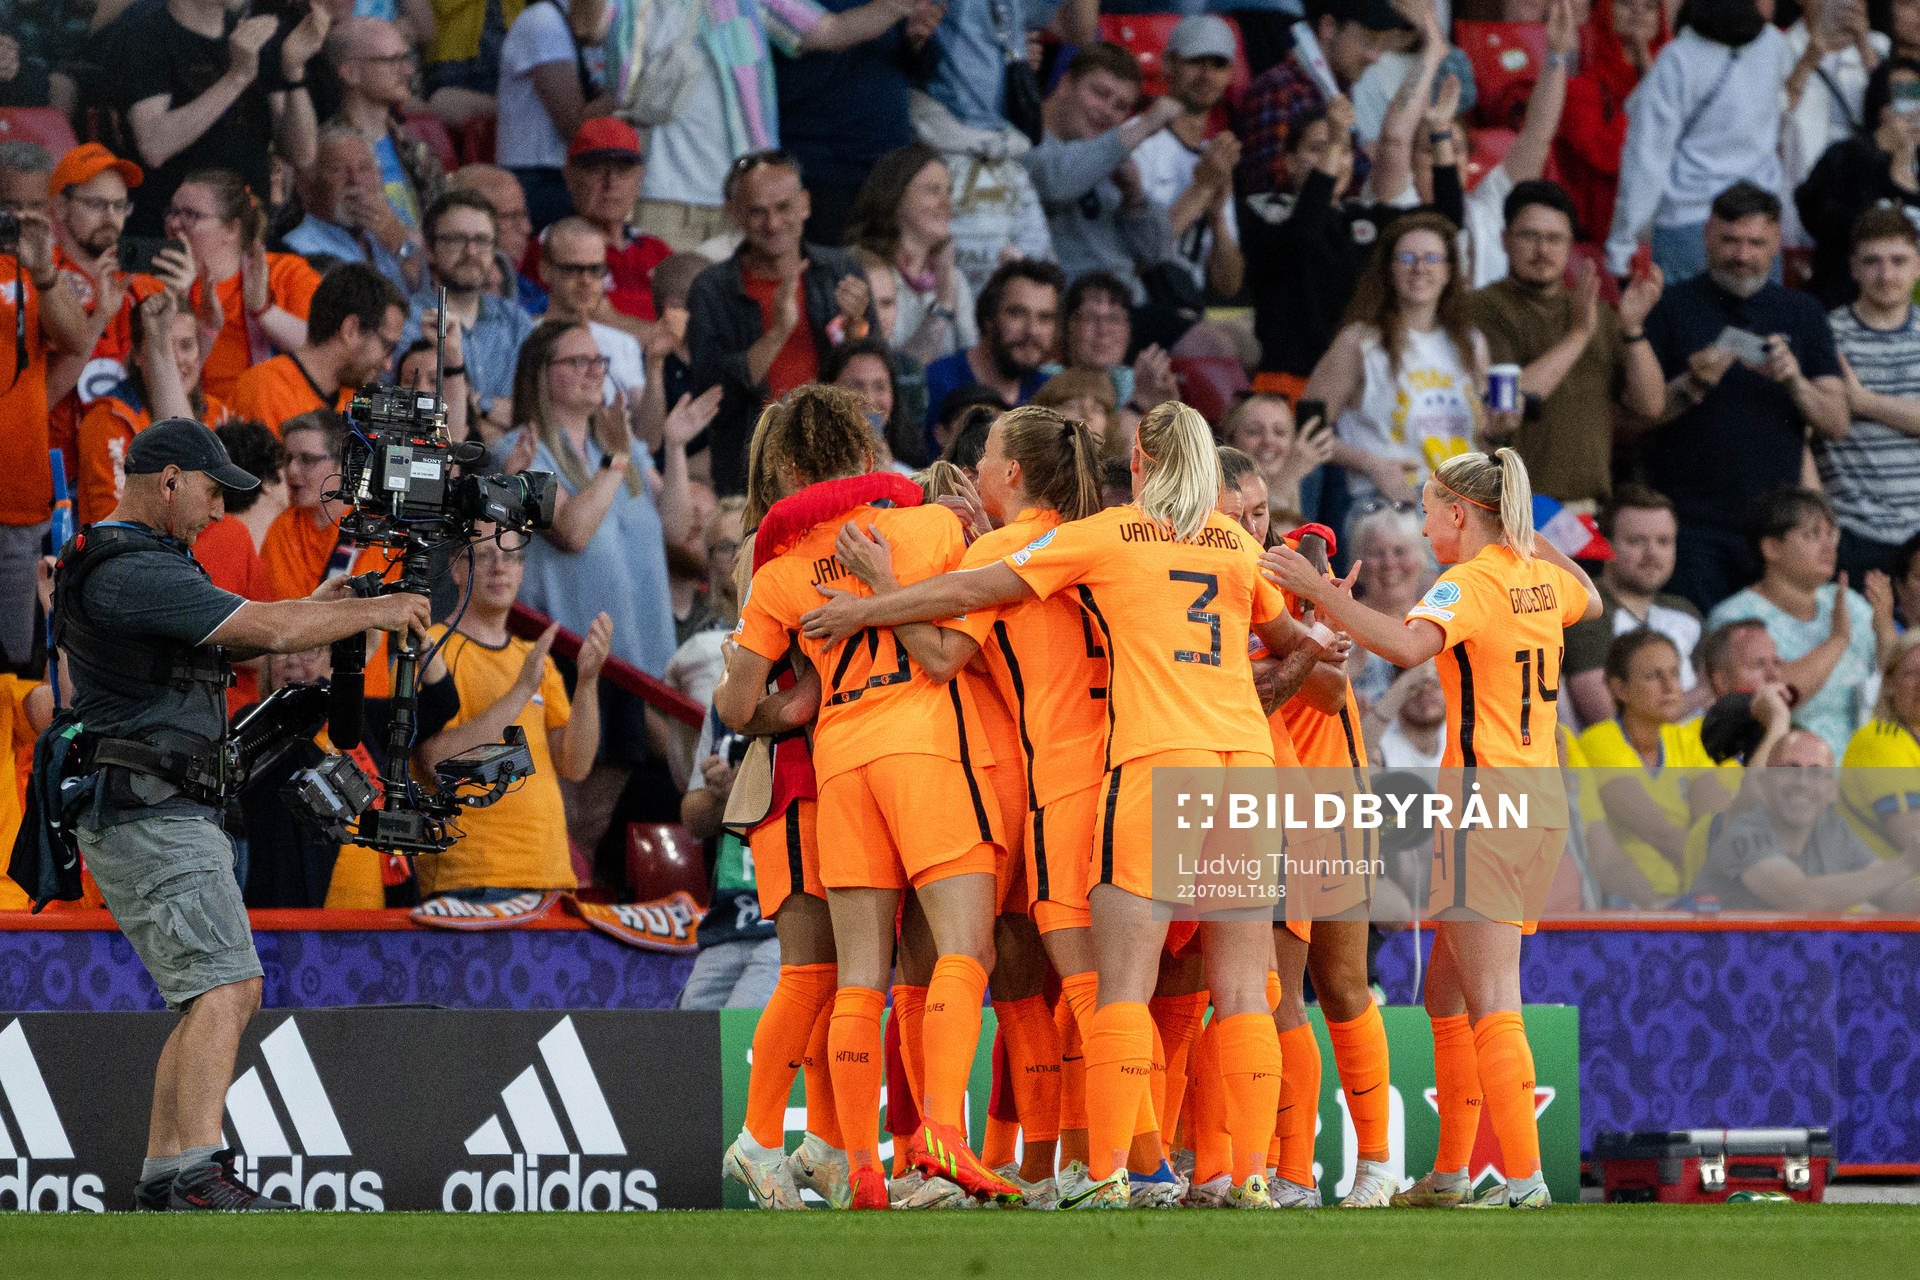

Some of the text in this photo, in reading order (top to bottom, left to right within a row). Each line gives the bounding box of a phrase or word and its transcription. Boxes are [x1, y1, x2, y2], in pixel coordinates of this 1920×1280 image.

[1119, 522, 1157, 543] VAN
[1168, 569, 1222, 668] 3
[1509, 583, 1558, 614] GROENEN
[1515, 646, 1564, 746] 14
[442, 1153, 658, 1213] adidas
